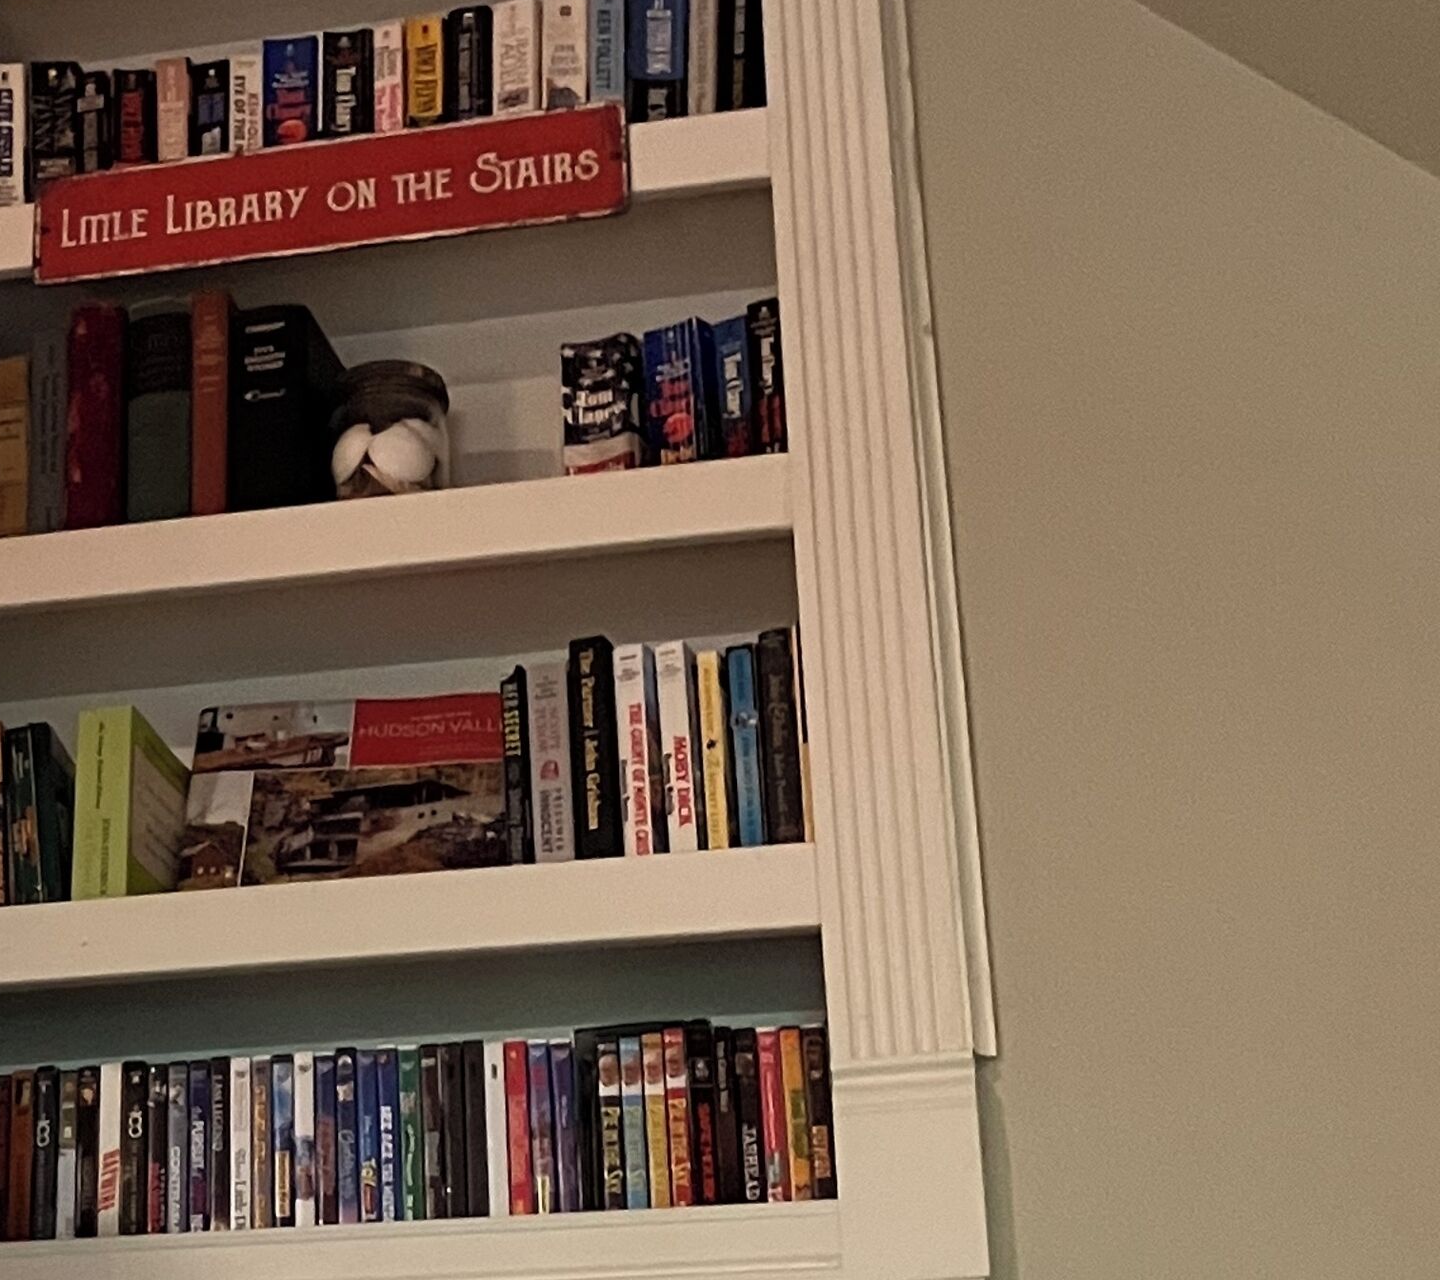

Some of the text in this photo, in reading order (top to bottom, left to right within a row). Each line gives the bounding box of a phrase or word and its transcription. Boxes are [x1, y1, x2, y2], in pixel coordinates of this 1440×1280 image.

[596, 9, 612, 90] KEN FOLLETT
[234, 99, 245, 114] OF
[234, 117, 245, 140] THE
[359, 720, 445, 737] HUDSON
[673, 736, 692, 827] MOBY DICK
[540, 790, 553, 853] INNOCENT
[742, 1123, 761, 1201] JARHEAD
